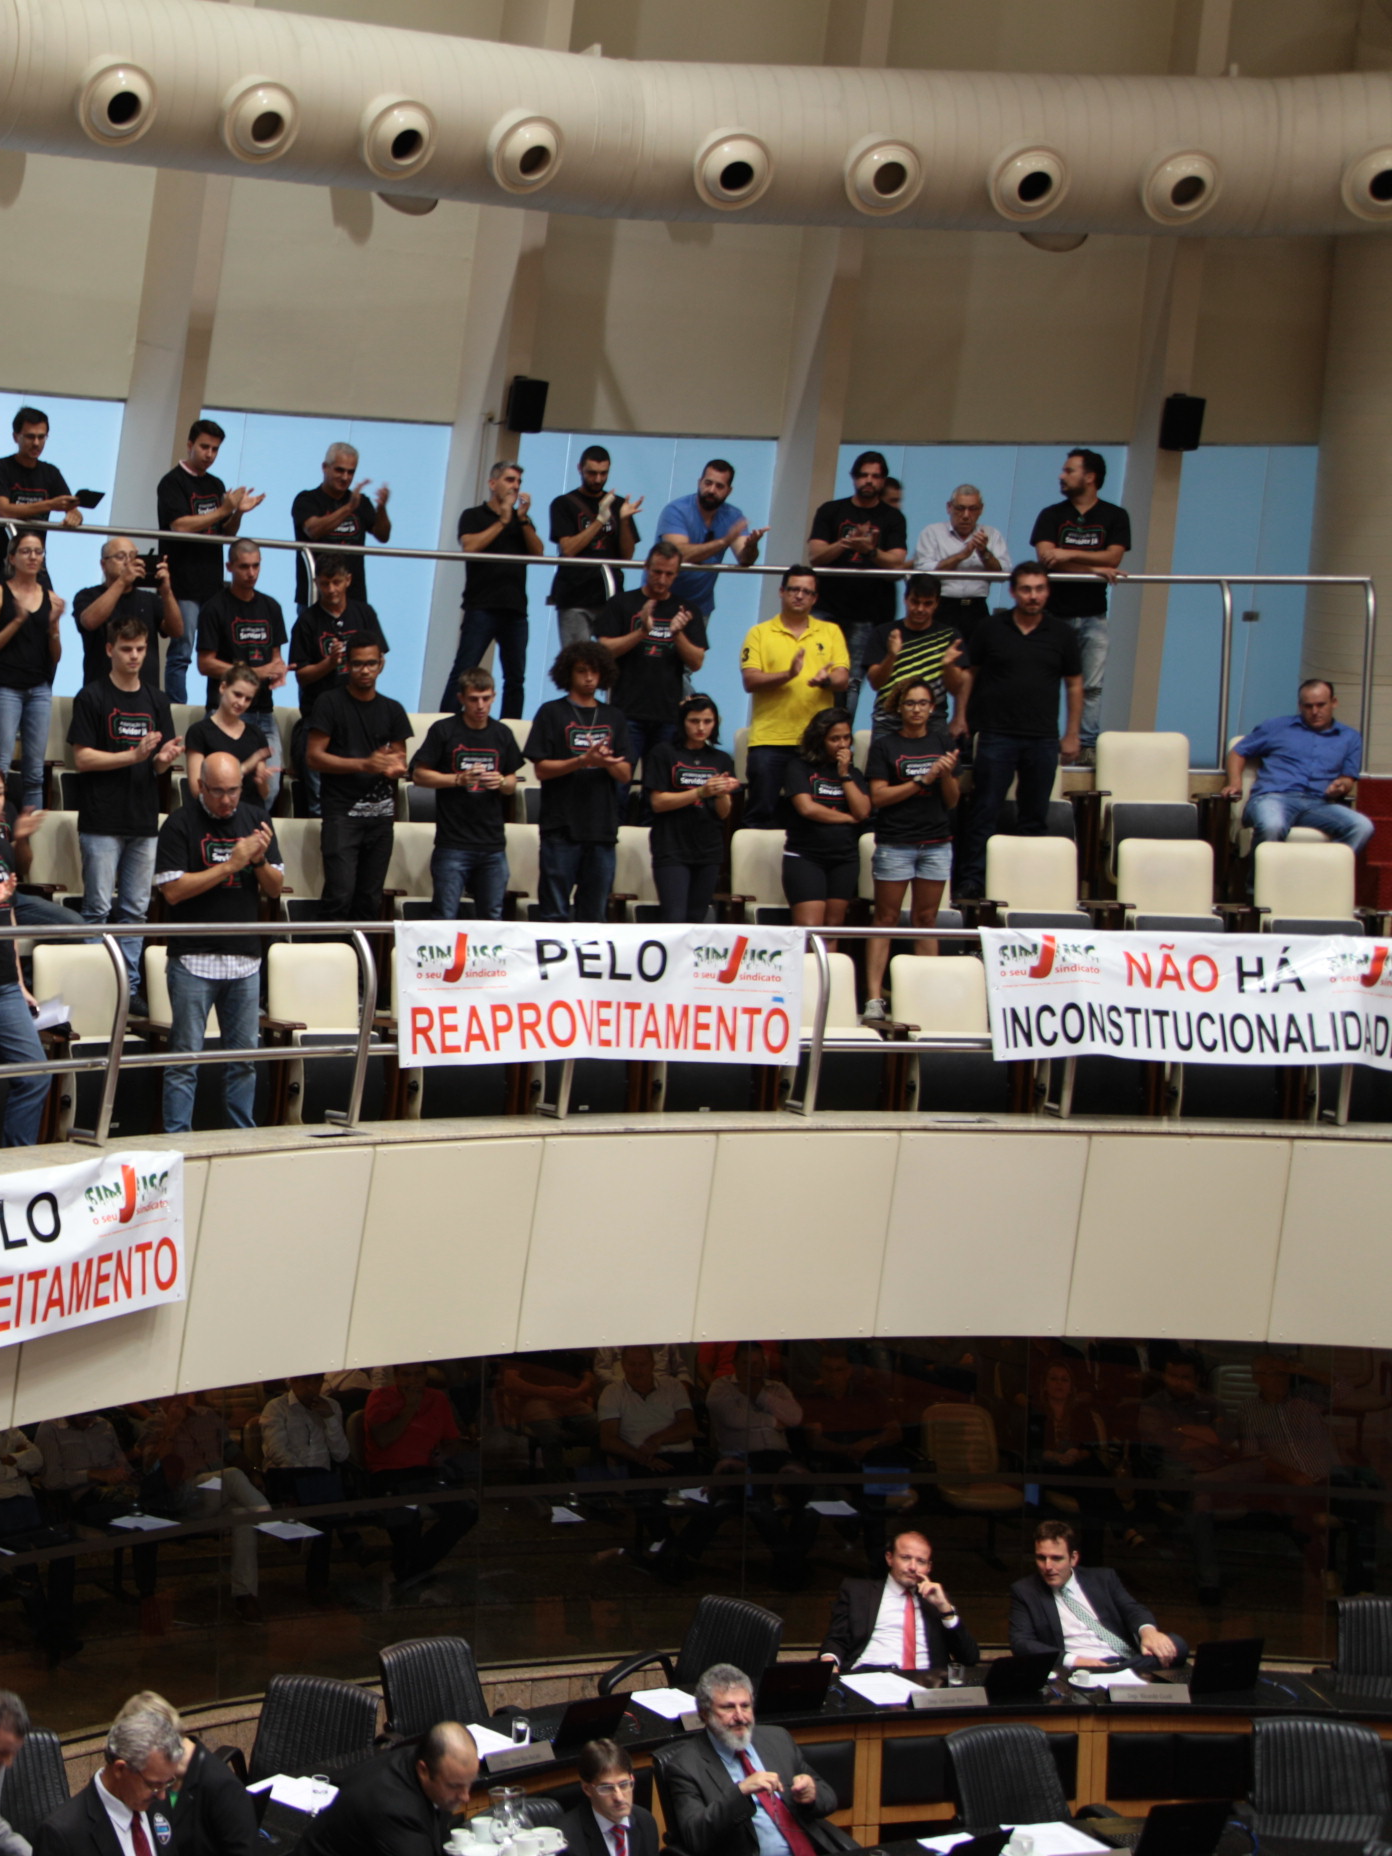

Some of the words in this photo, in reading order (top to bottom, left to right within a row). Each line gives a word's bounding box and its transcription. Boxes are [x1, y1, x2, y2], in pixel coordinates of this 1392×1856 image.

[741, 647, 750, 662] 3
[425, 971, 442, 980] seu
[465, 967, 507, 979] sindicato
[536, 938, 668, 983] PELO
[1008, 969, 1027, 978] seu
[1054, 963, 1100, 974] sindicato
[1122, 943, 1219, 993] NÃO
[1236, 946, 1306, 993] HÁ
[701, 971, 718, 980] seu
[738, 971, 782, 982] sindicato
[410, 1000, 790, 1054] REAPROVEITAMENTO
[1002, 1001, 1392, 1060] INCONSTITUCIONALIDAD
[101, 1214, 118, 1225] seu
[136, 1199, 170, 1216] sindicato
